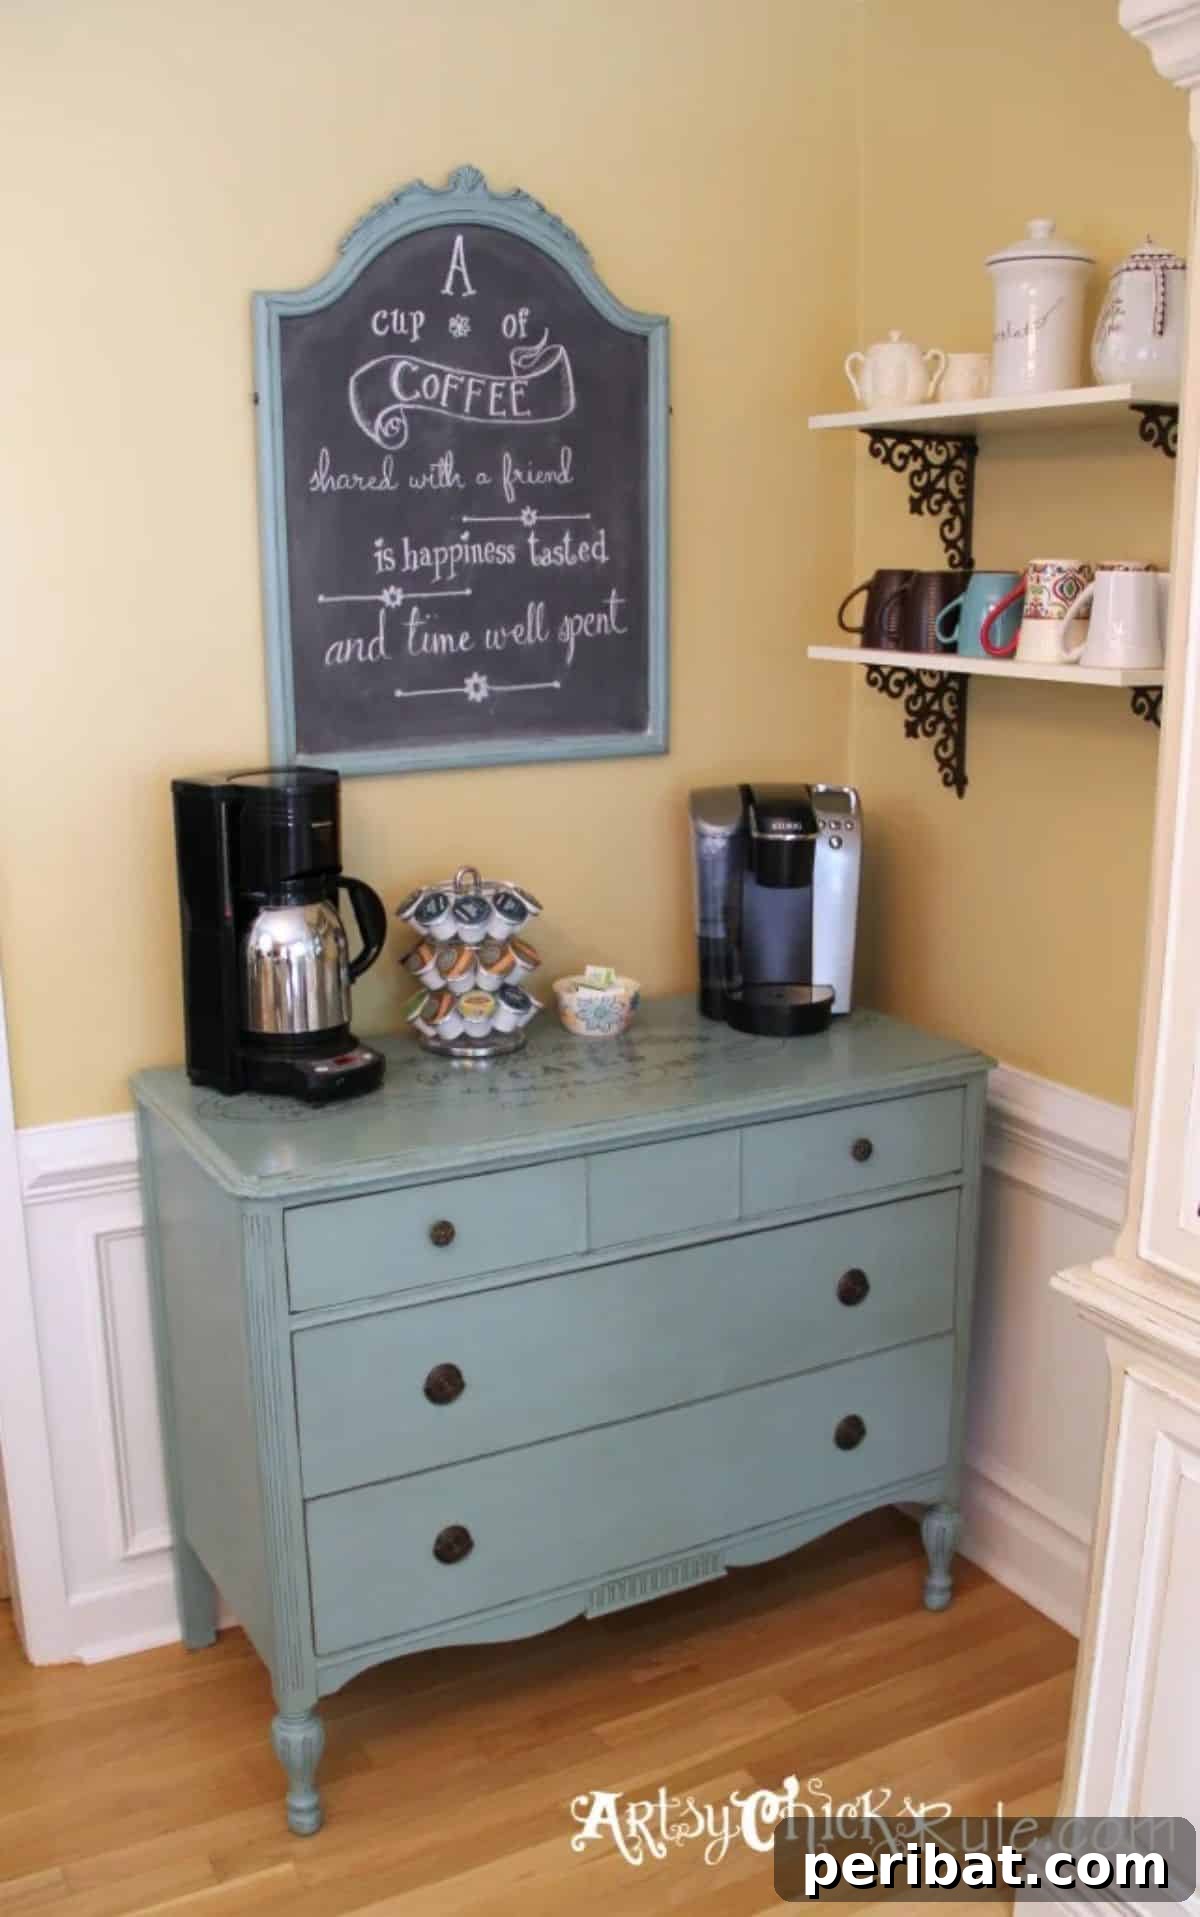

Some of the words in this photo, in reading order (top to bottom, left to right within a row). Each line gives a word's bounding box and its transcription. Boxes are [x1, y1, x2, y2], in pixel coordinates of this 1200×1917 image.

[441, 234, 476, 296] A
[371, 309, 425, 341] cup
[503, 307, 529, 338] of
[391, 359, 531, 416] COFFEE
[309, 448, 398, 491] shared
[408, 449, 465, 489] with
[476, 470, 490, 485] a
[503, 447, 573, 502] friend
[373, 537, 395, 573] is
[402, 531, 516, 582] happiness
[529, 530, 609, 567] tasted
[324, 607, 390, 666] and
[403, 605, 474, 656] time
[485, 602, 551, 646] well
[557, 588, 628, 664] spent
